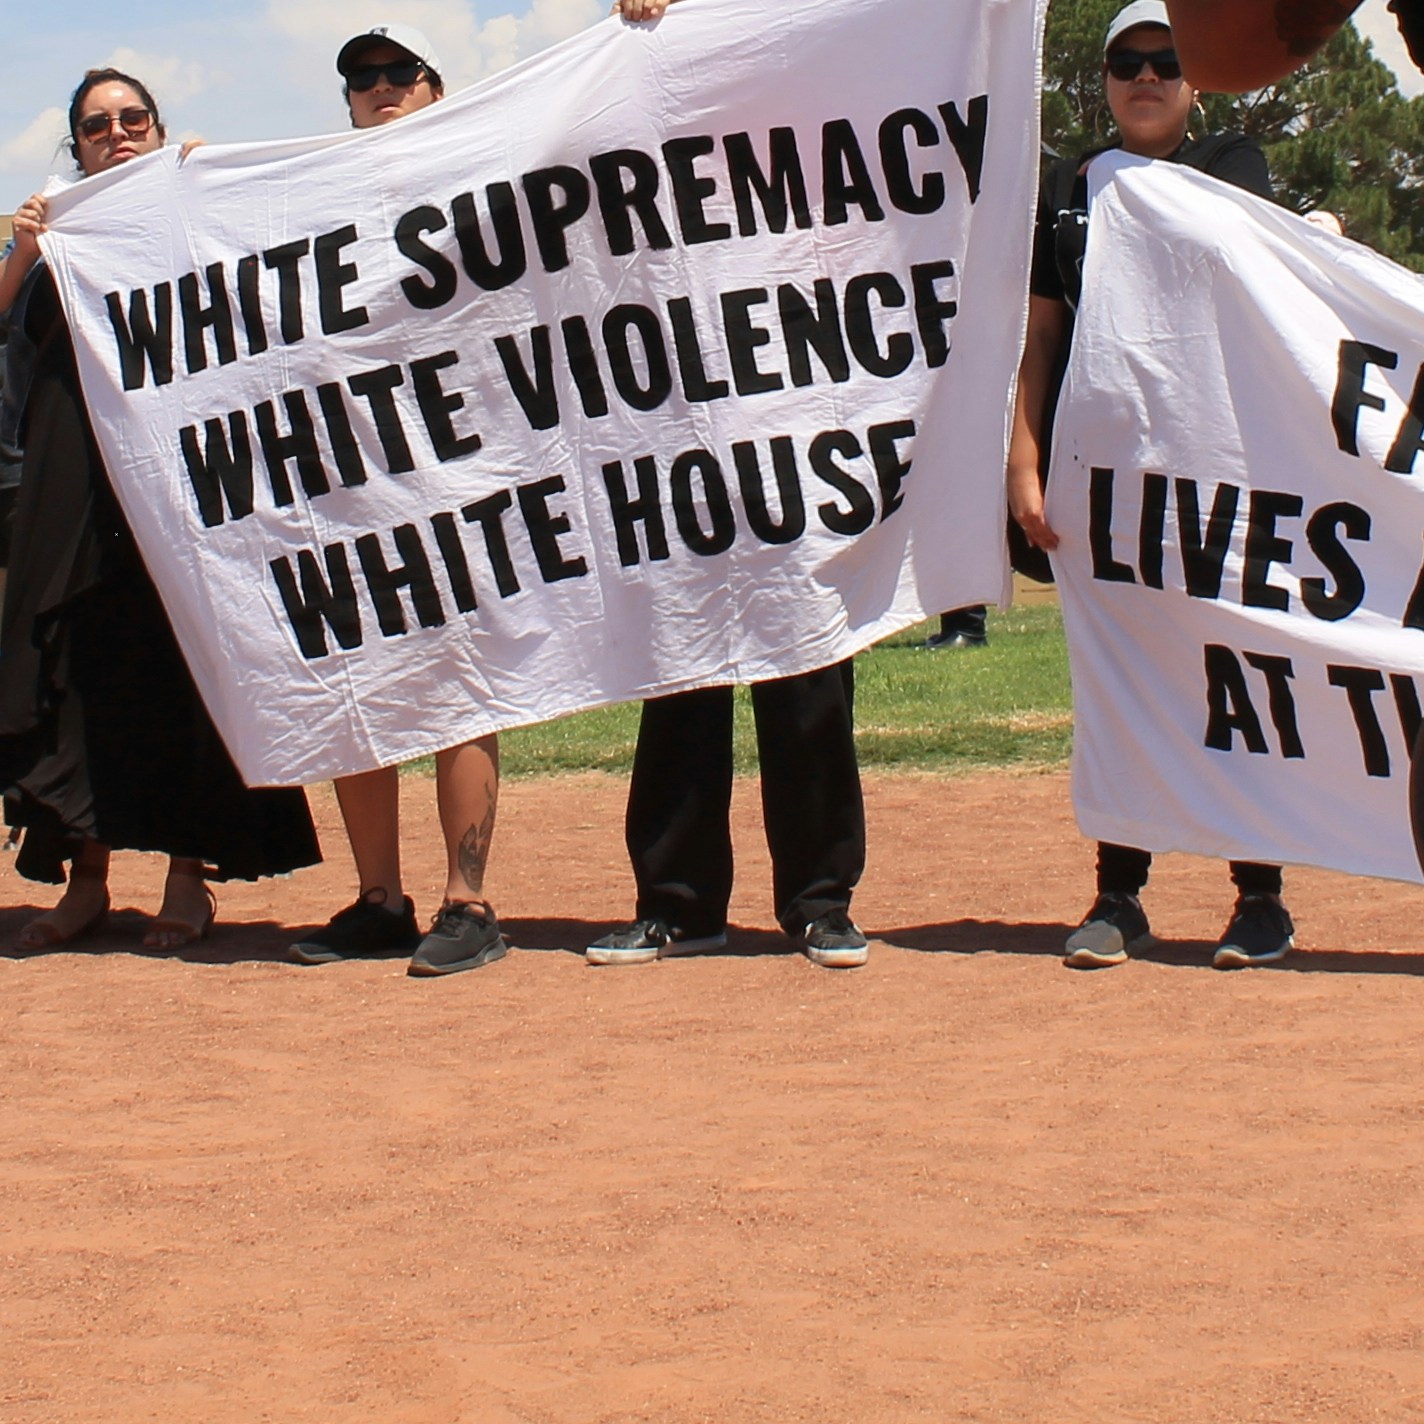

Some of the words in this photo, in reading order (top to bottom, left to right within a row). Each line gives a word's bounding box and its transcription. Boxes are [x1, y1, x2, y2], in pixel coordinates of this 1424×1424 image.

[103, 224, 370, 392] WHITE
[393, 94, 990, 310] SUPREMACY
[178, 350, 483, 529] WHITE
[493, 260, 959, 431] VIOLENCE
[268, 474, 589, 660] WHITE
[601, 419, 917, 568] HOUSE
[1088, 466, 1373, 622] LIVES
[1203, 643, 1306, 759] AT
